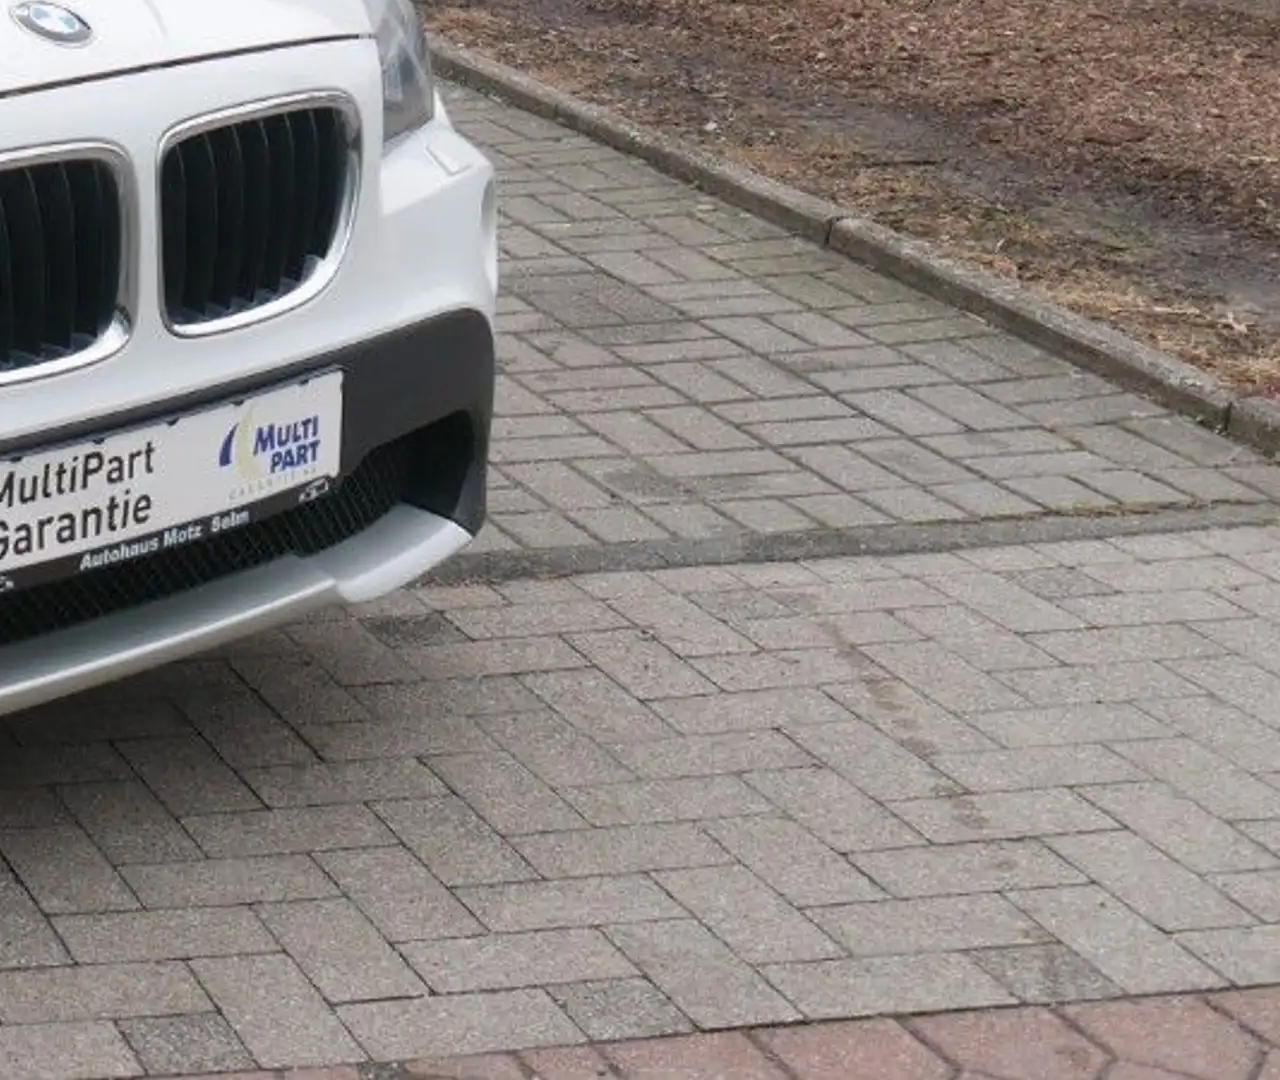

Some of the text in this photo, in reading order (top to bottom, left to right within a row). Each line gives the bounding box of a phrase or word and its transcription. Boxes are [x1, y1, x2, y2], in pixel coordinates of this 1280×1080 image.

[252, 414, 319, 457] MULTI
[269, 438, 321, 474] PART
[79, 537, 160, 571] Autohaus
